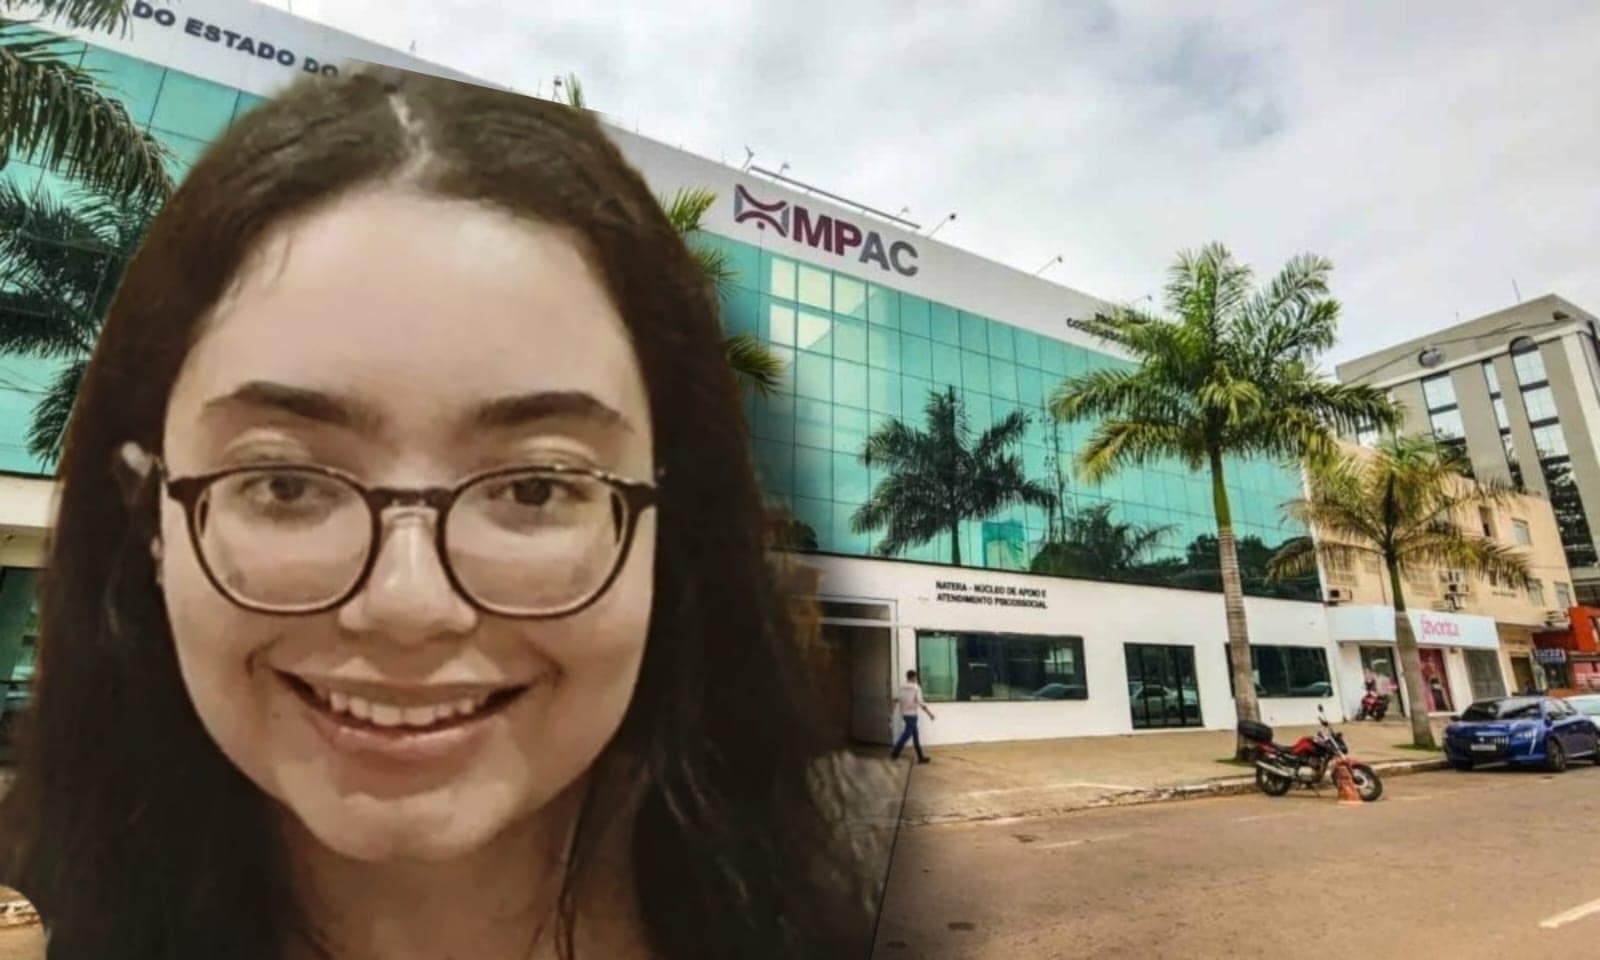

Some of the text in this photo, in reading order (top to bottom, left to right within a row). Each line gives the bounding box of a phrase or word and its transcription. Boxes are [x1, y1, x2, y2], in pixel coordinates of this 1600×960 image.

[133, 1, 175, 26] DO
[184, 17, 296, 67] ESTADO
[793, 205, 918, 277] MPAC
[936, 581, 967, 591] NATERA
